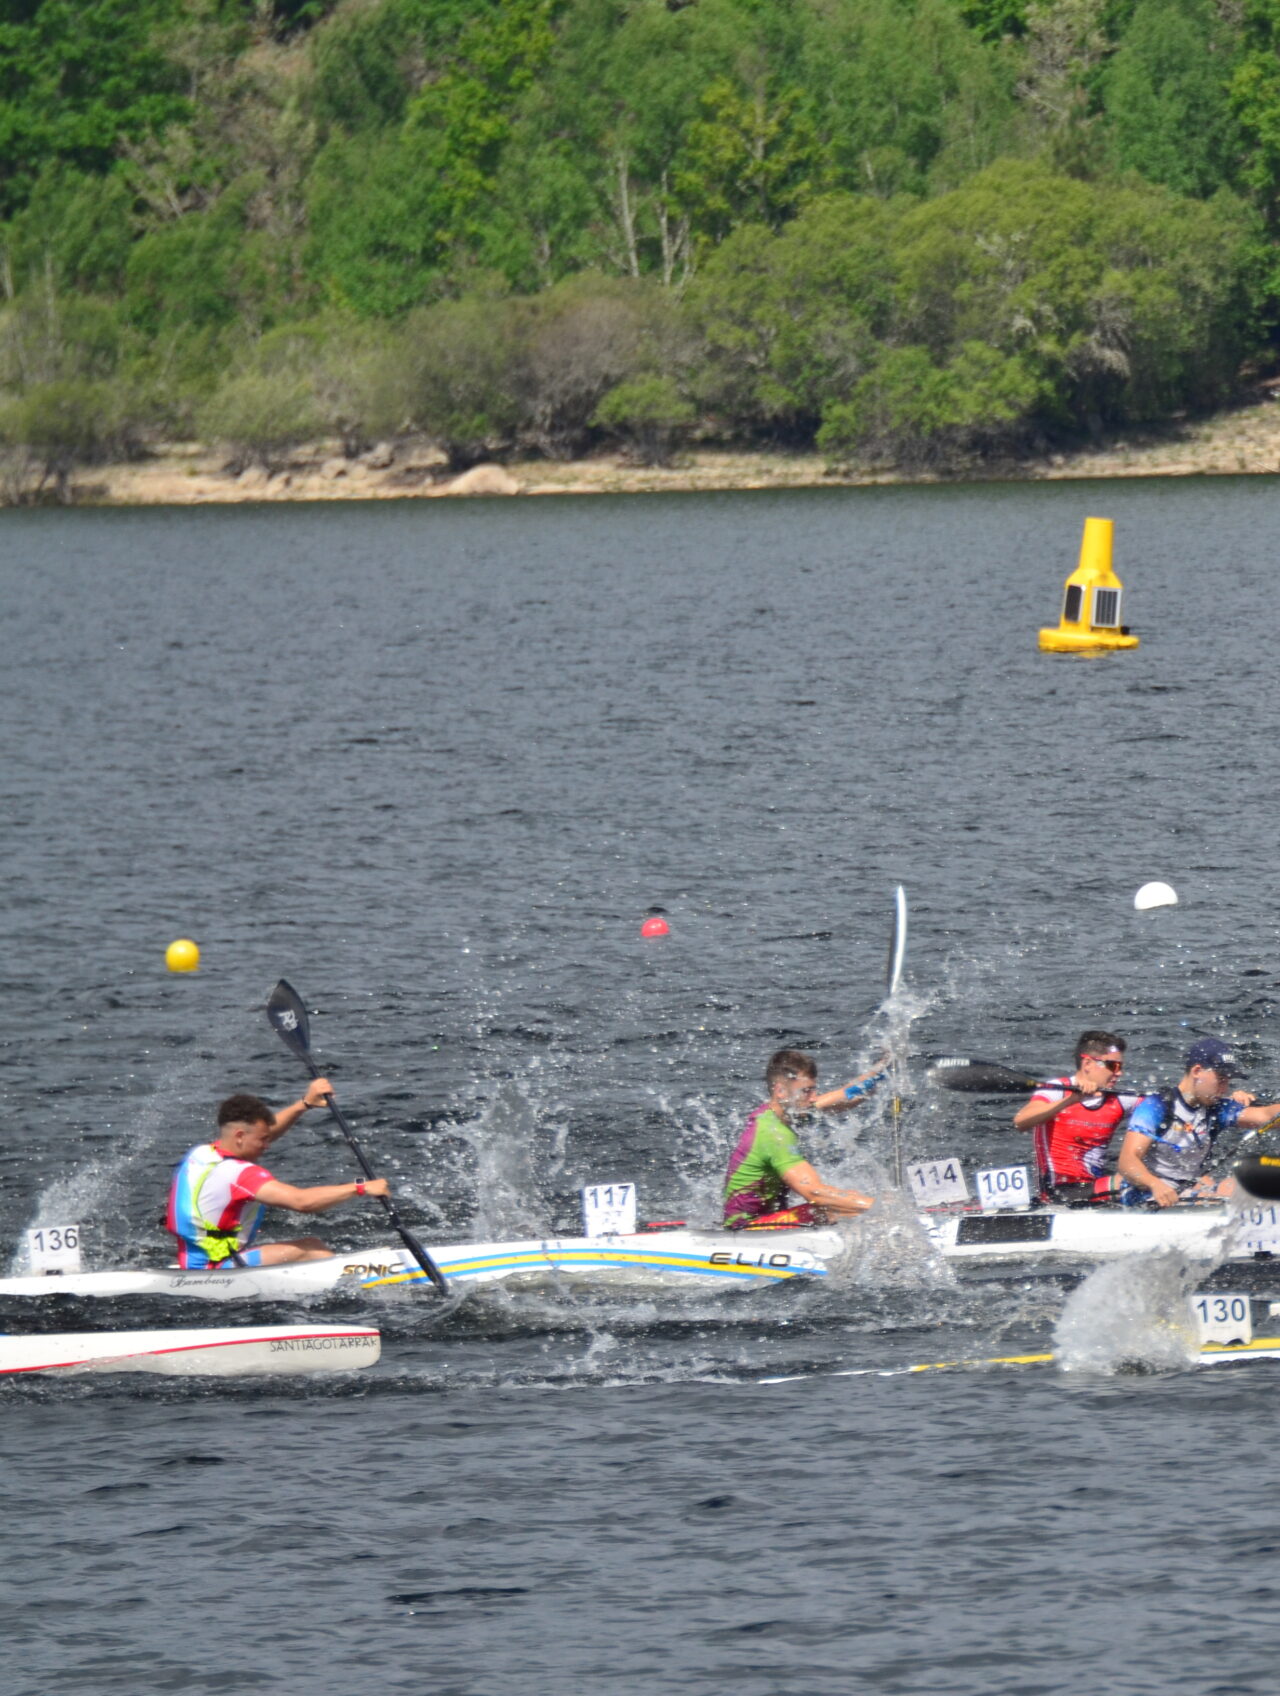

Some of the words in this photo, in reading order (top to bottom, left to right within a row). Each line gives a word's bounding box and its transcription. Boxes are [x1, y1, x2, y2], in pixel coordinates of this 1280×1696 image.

[914, 1163, 957, 1187] 114
[982, 1170, 1024, 1194] 106
[589, 1186, 632, 1208] 117
[34, 1227, 78, 1252] 136
[342, 1263, 405, 1277] SONIC
[708, 1251, 792, 1268] ELIO
[1197, 1298, 1247, 1323] 130
